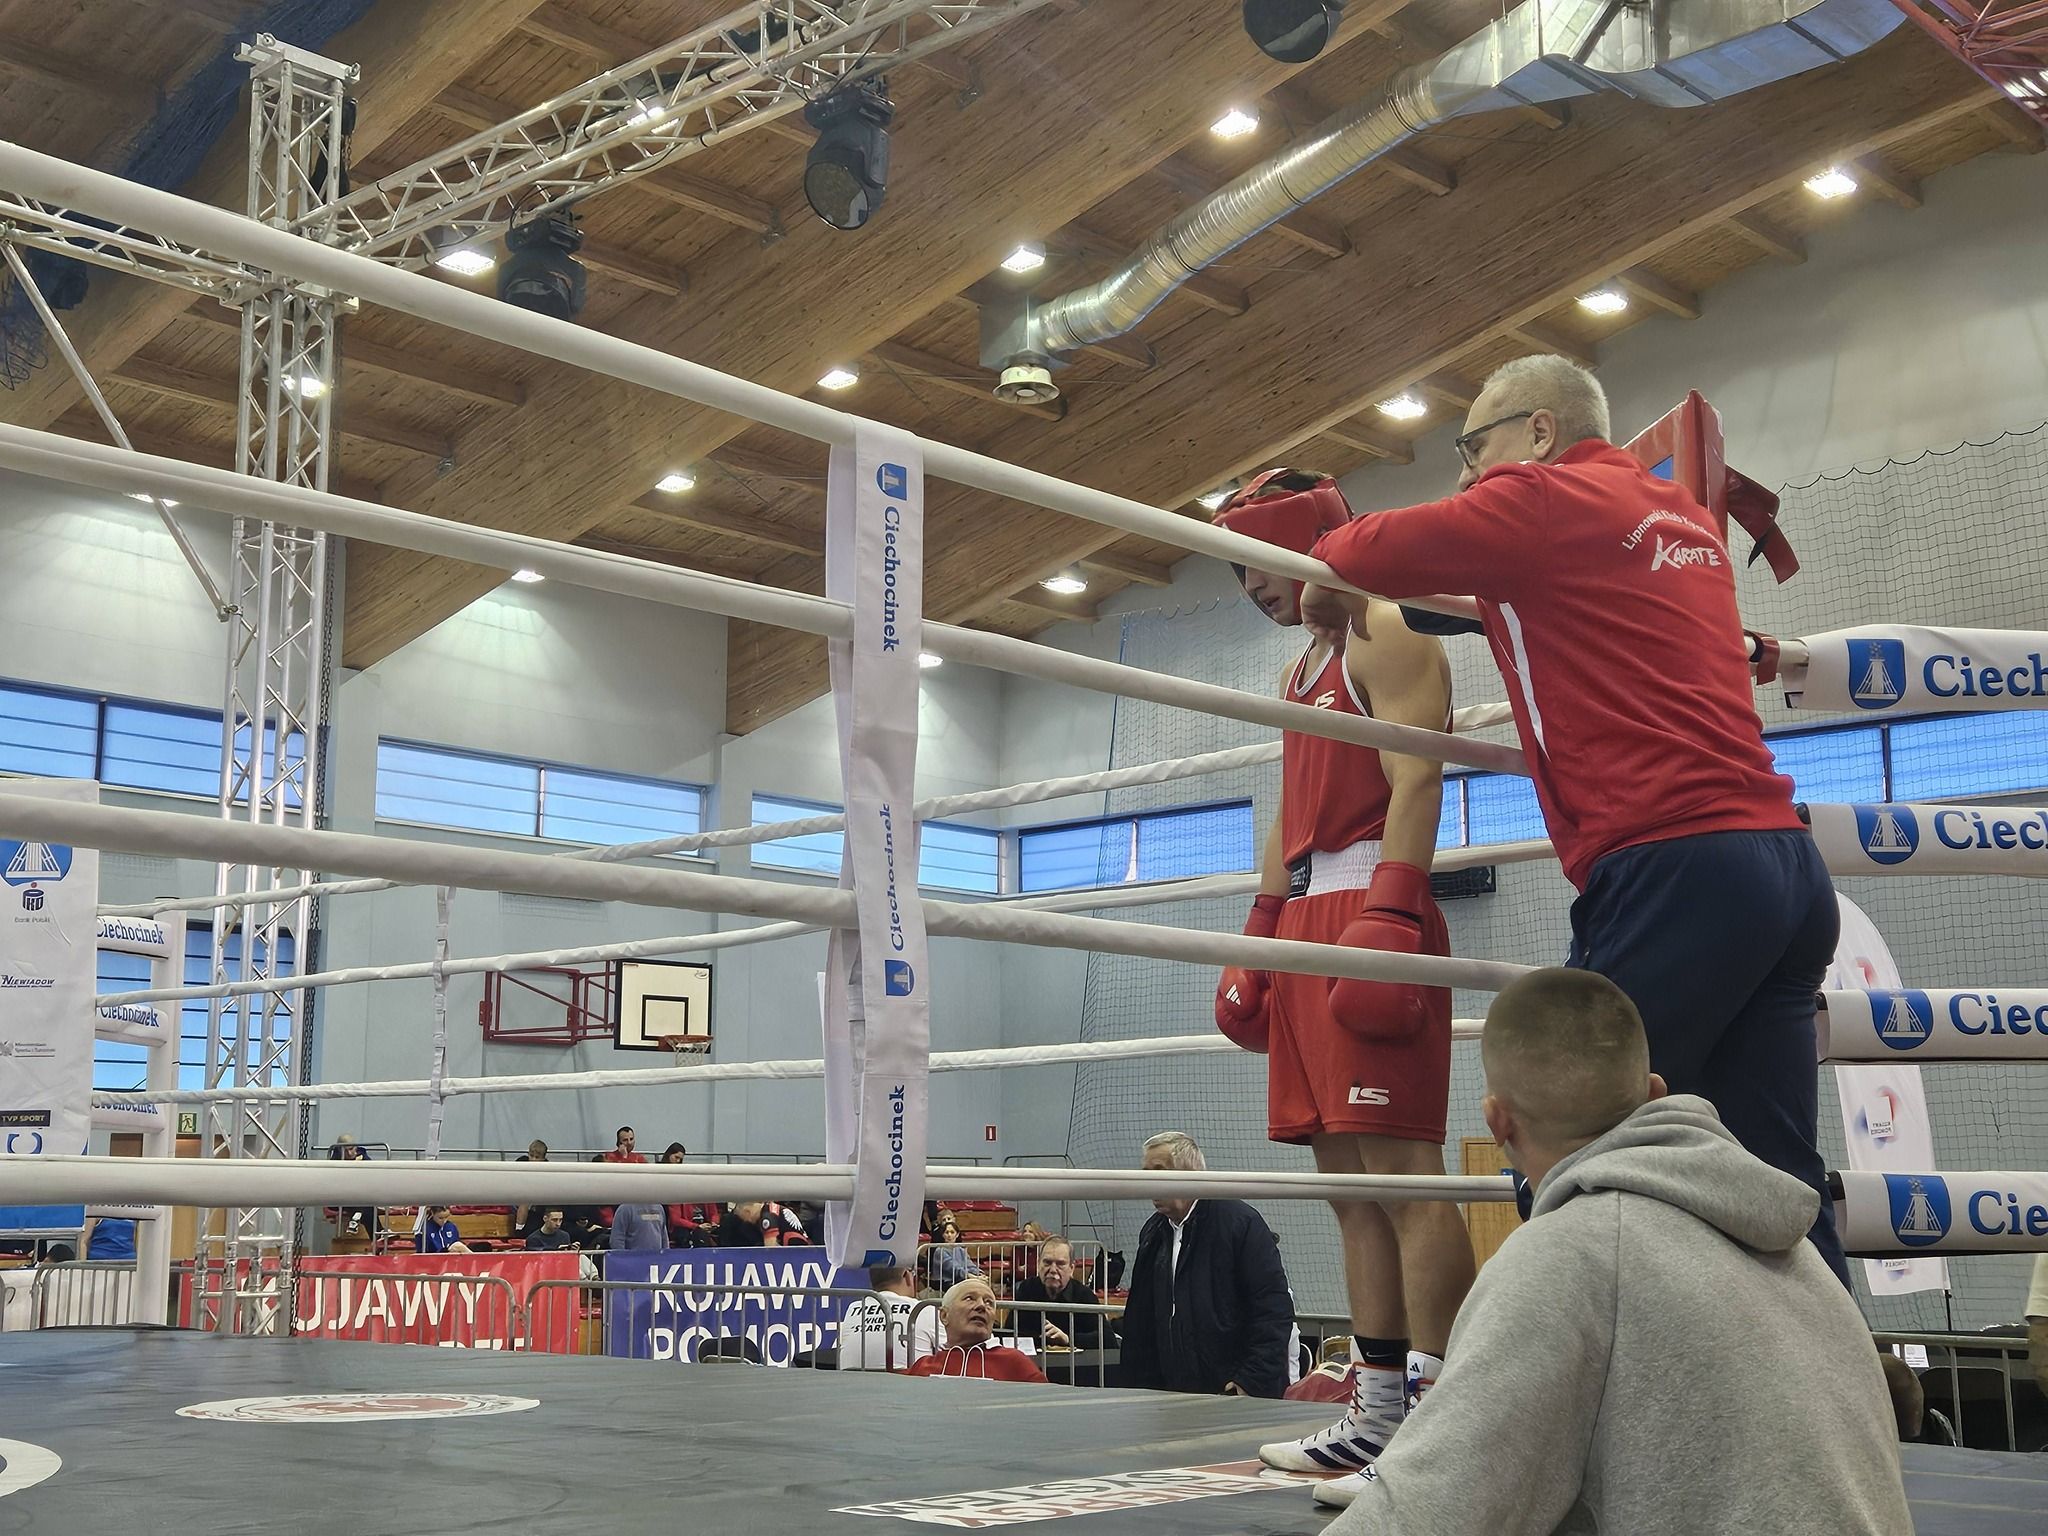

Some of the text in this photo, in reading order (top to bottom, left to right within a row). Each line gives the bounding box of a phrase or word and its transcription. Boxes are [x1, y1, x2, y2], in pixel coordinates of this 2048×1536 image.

[882, 504, 900, 652] Ciechocinek
[880, 803, 905, 953] Ciechocinek
[878, 1084, 905, 1241] Ciechocinek
[650, 1262, 838, 1313] KUJAWY
[842, 1472, 1208, 1517] SYSTEM
[932, 1479, 1282, 1528] ENERGY
